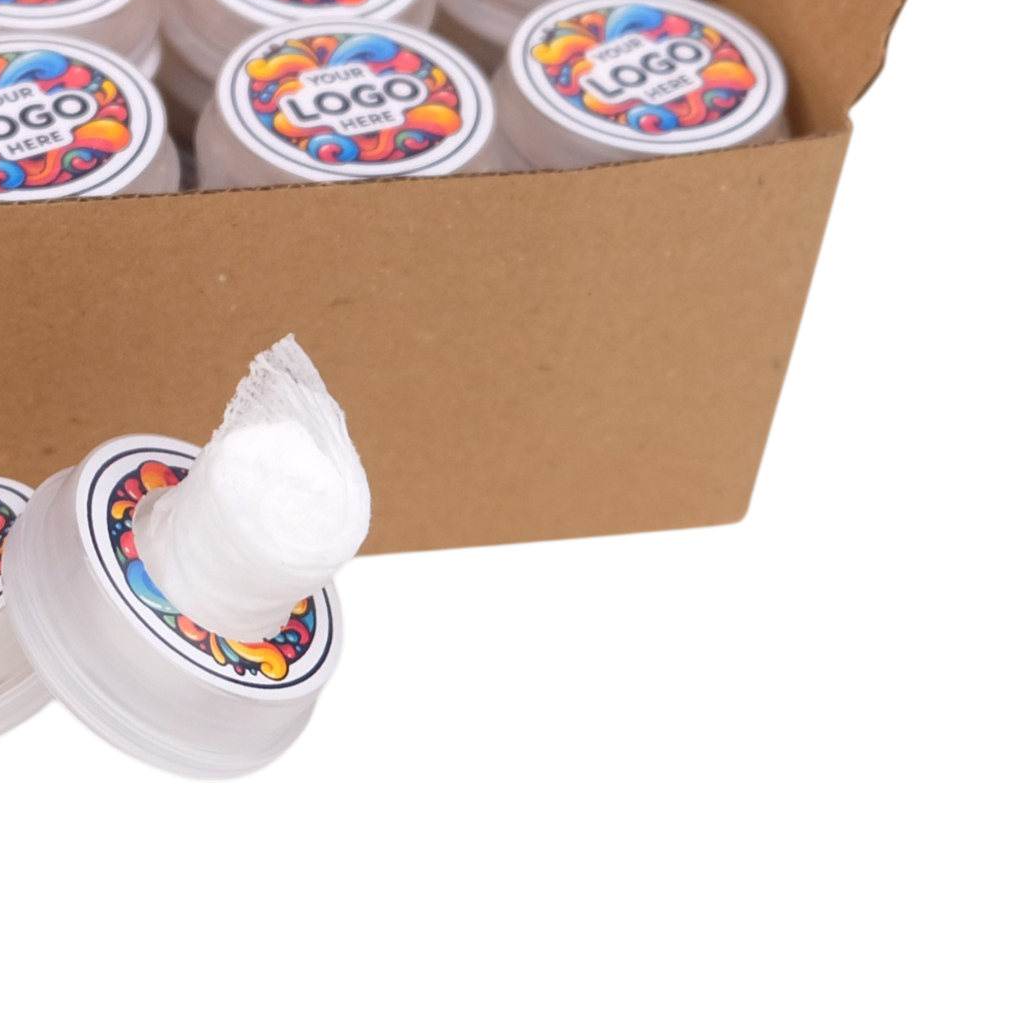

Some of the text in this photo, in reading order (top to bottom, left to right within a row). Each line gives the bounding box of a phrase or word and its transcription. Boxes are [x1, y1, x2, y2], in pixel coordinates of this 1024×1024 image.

[597, 38, 643, 60] YOUR
[308, 67, 365, 86] YOUR
[586, 41, 702, 96] LOGO
[286, 77, 421, 123] LOGO
[646, 75, 695, 100] HERE
[339, 111, 397, 131] HERE
[6, 131, 65, 156] HERE
